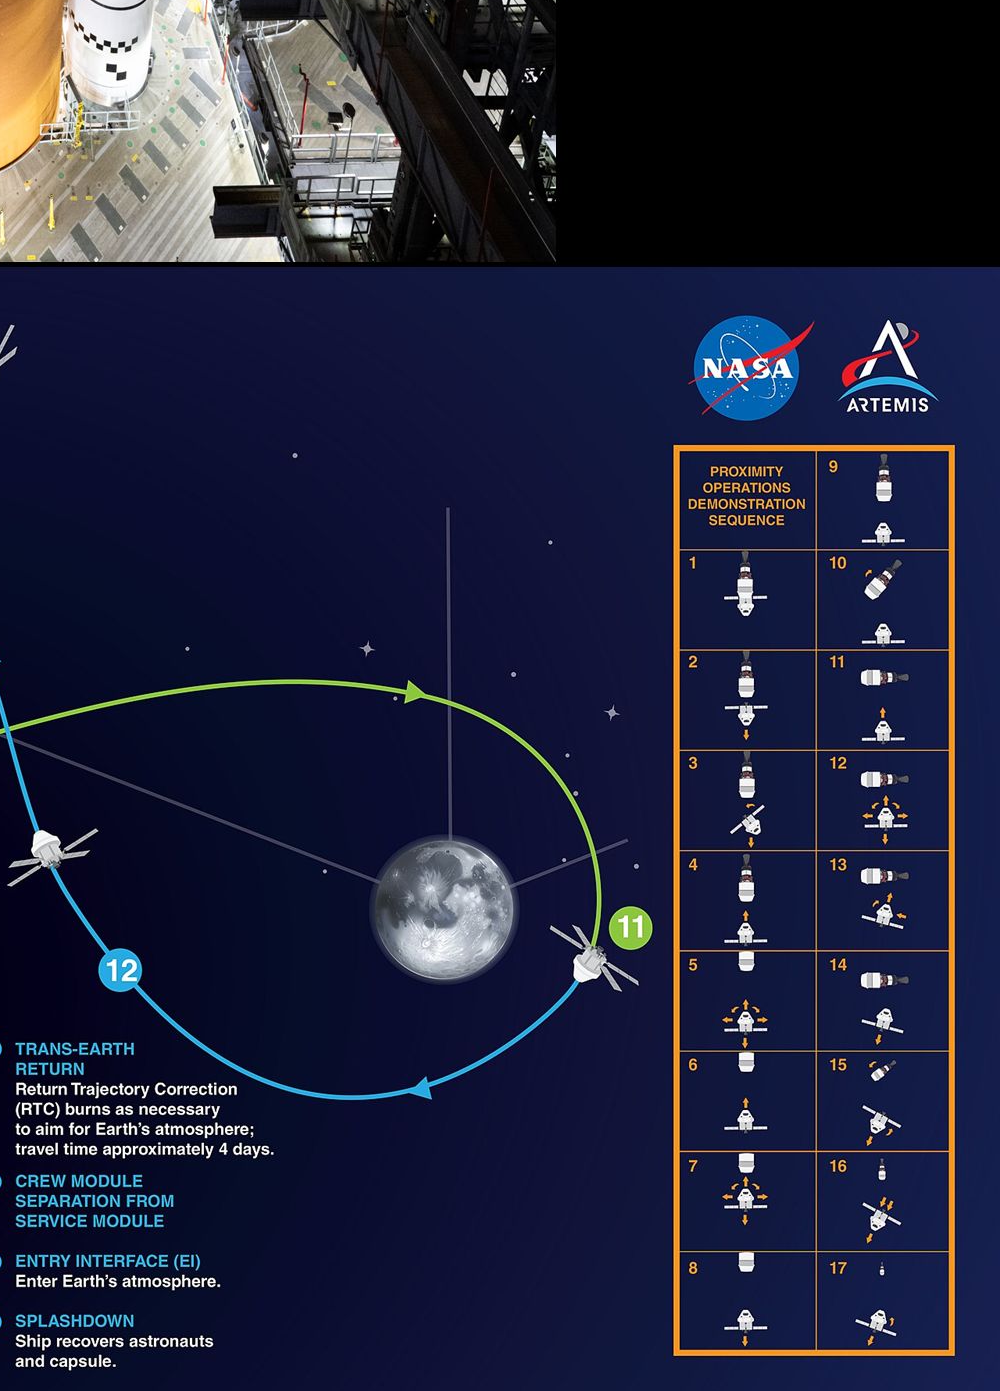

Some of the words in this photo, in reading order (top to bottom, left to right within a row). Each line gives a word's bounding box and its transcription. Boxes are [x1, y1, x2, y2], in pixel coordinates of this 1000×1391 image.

[702, 357, 795, 381] NASA
[846, 397, 930, 413] ARTEMIS
[710, 465, 784, 478] PROXIMITY
[828, 459, 838, 473] 9
[702, 481, 791, 494] OPERATIONS
[688, 498, 806, 510] DEMONSTRATION
[708, 514, 785, 526] SEQUENCE
[689, 556, 696, 569] 1
[829, 556, 847, 570] 10
[688, 655, 698, 668] 2
[829, 655, 844, 668] 11
[688, 756, 698, 770] 3
[829, 756, 847, 770] 12
[688, 858, 698, 871] 4
[830, 857, 847, 871] 13
[618, 915, 643, 938] 11
[107, 959, 138, 982] 12
[688, 958, 698, 972] 5
[829, 958, 847, 971] 14
[688, 1058, 698, 1071] 6
[829, 1058, 847, 1071] 15
[688, 1159, 698, 1172] 7
[829, 1159, 847, 1173] 16
[15, 1173, 67, 1188] CREW
[71, 1173, 143, 1188] MODULE
[15, 1193, 121, 1208] SEPARATION
[126, 1193, 175, 1208] FROM
[15, 1213, 88, 1228] SERVICE
[93, 1213, 165, 1228] MODULE
[15, 1253, 71, 1268] ENTRY
[75, 1253, 169, 1268] INTERFACE
[173, 1253, 201, 1271] (EI)
[688, 1261, 698, 1275] 8
[829, 1261, 848, 1275] 17
[15, 1273, 59, 1288] Enter
[62, 1273, 118, 1289] Earth’s
[121, 1273, 221, 1291] atmosphere.
[15, 1313, 135, 1328] SPLASHDOWN
[15, 1333, 52, 1351] Ship
[56, 1337, 125, 1349] recovers
[129, 1335, 215, 1349] astronauts
[15, 1353, 45, 1368] and
[49, 1353, 117, 1371] capsule.
